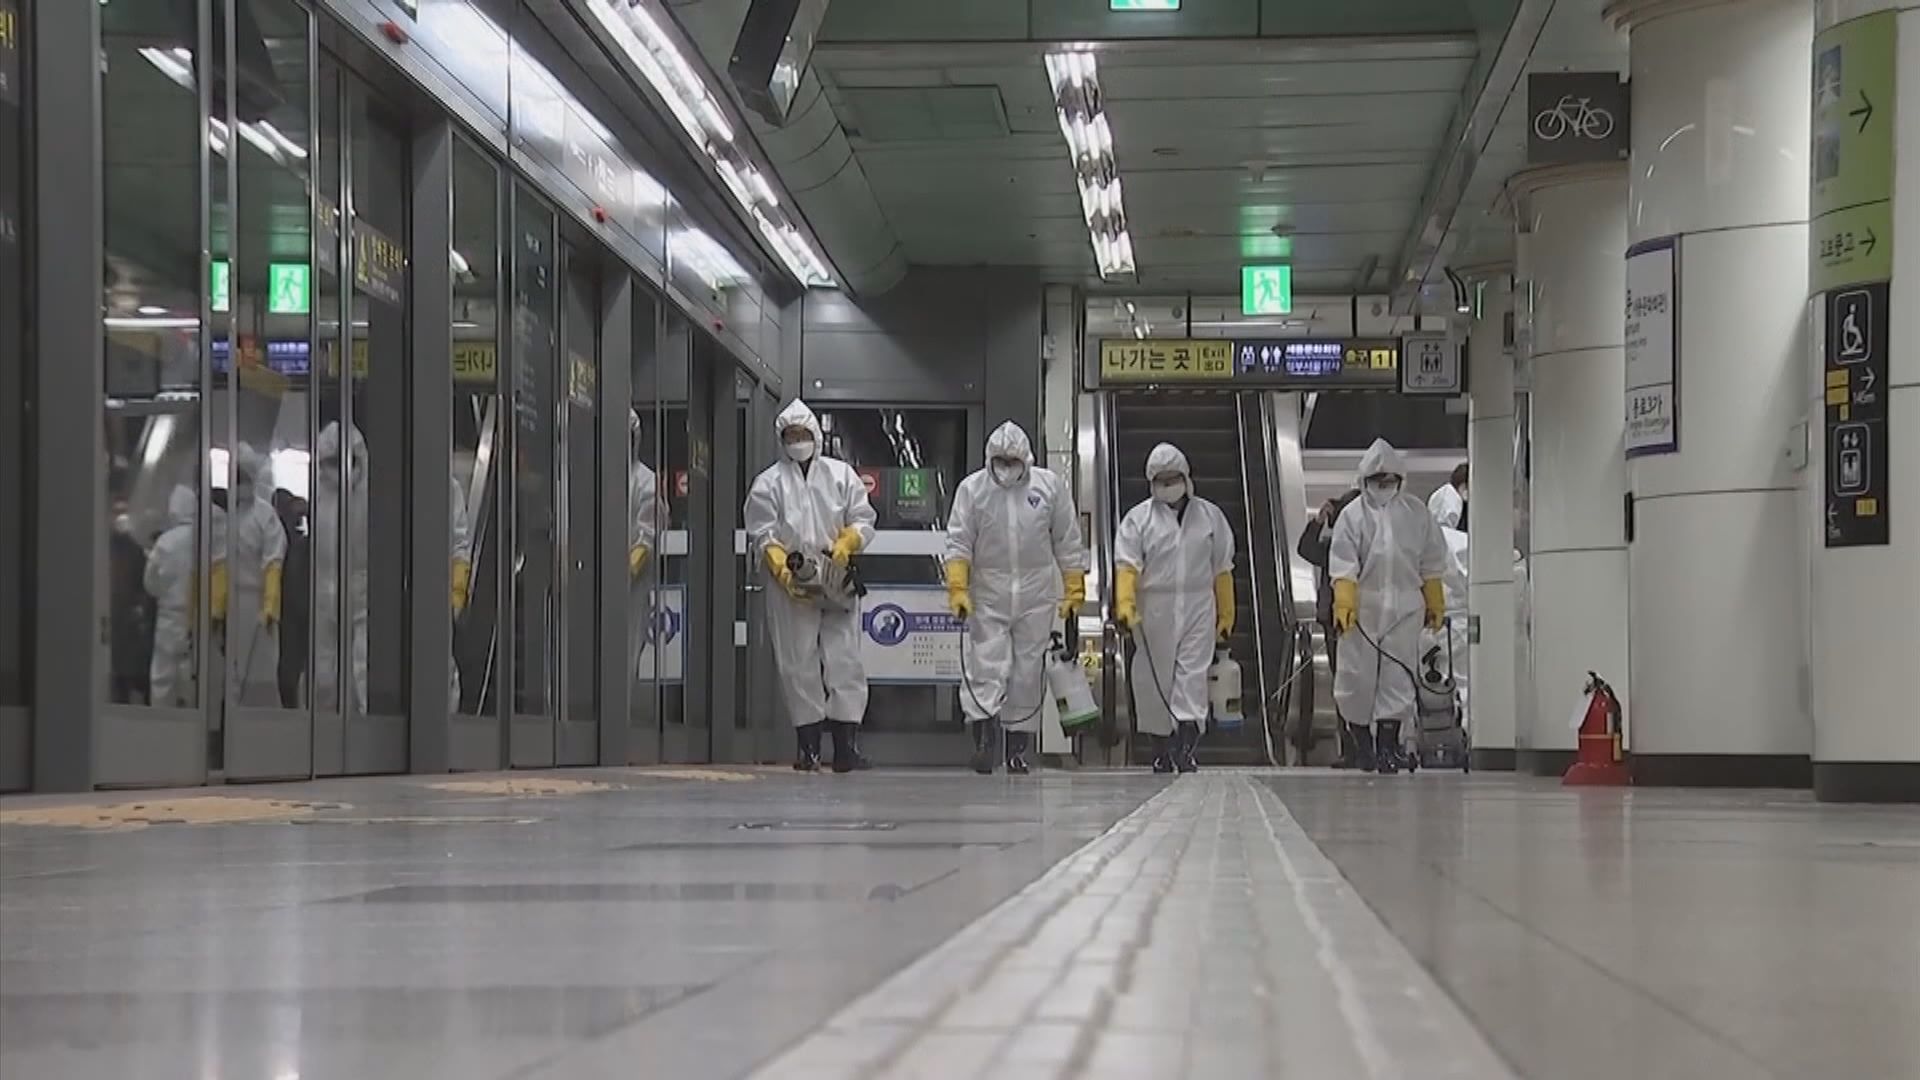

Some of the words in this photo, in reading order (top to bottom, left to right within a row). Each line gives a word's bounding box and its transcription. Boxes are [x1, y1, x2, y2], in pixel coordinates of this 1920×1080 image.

[1108, 348, 1166, 370] 나가는
[1173, 348, 1190, 370] 곳
[1202, 347, 1225, 358] Exit
